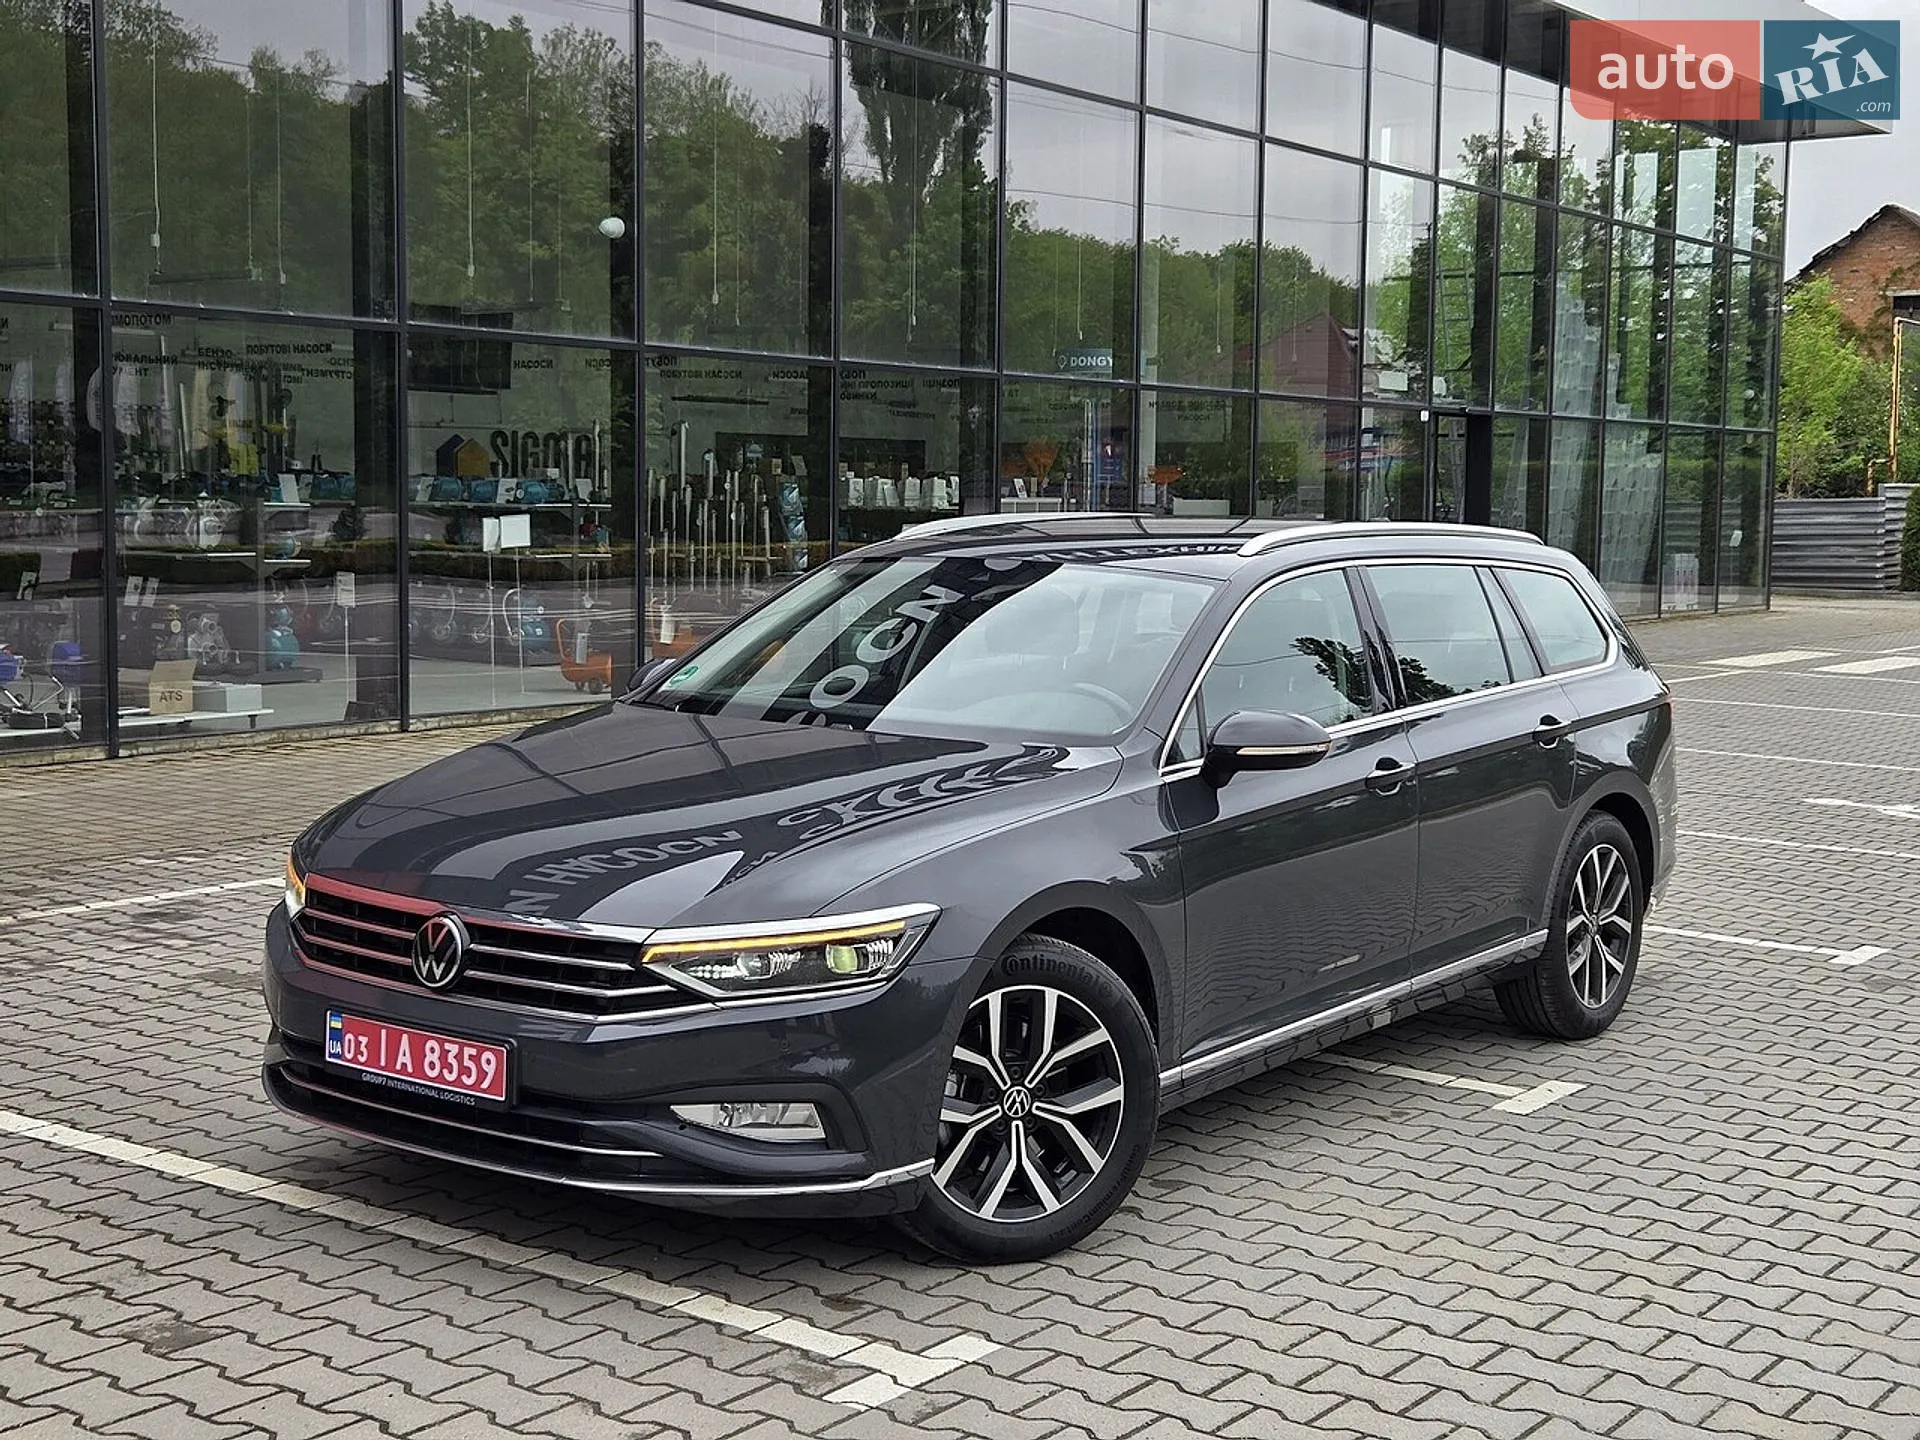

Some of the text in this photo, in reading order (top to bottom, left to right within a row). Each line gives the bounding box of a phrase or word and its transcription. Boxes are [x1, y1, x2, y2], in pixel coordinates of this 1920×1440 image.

[159, 690, 183, 702] ATS
[1002, 953, 1099, 986] Continental
[329, 1039, 342, 1055] UA
[344, 1033, 369, 1063] 03
[423, 1039, 498, 1090] 8359
[387, 1078, 439, 1098] INTERNATIONAL
[439, 1091, 476, 1106] LOGISTICS
